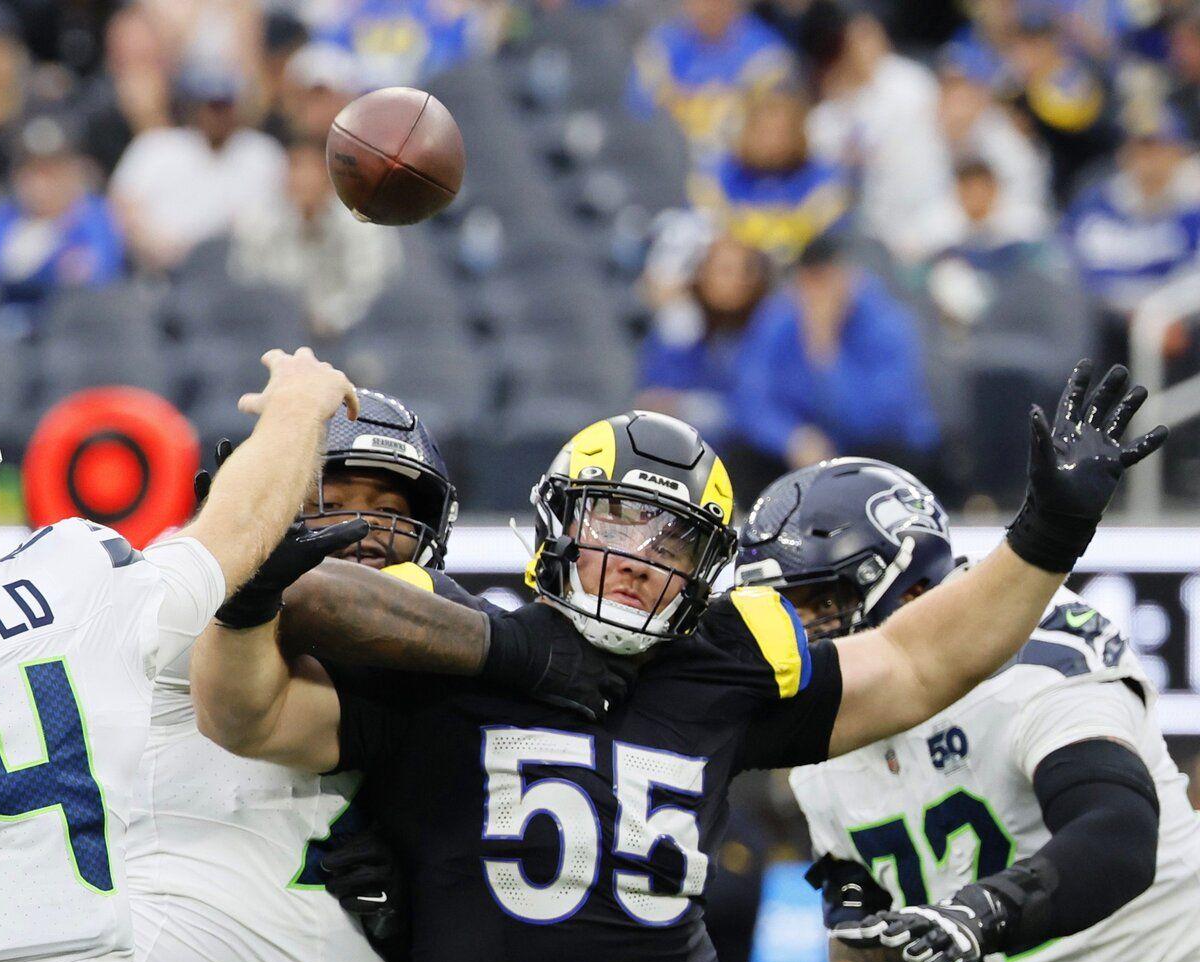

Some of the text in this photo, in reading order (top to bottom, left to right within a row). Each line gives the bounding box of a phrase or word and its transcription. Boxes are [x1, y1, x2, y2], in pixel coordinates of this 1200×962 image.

[638, 472, 680, 491] RAMS
[927, 726, 969, 770] 50
[480, 725, 710, 928] 55
